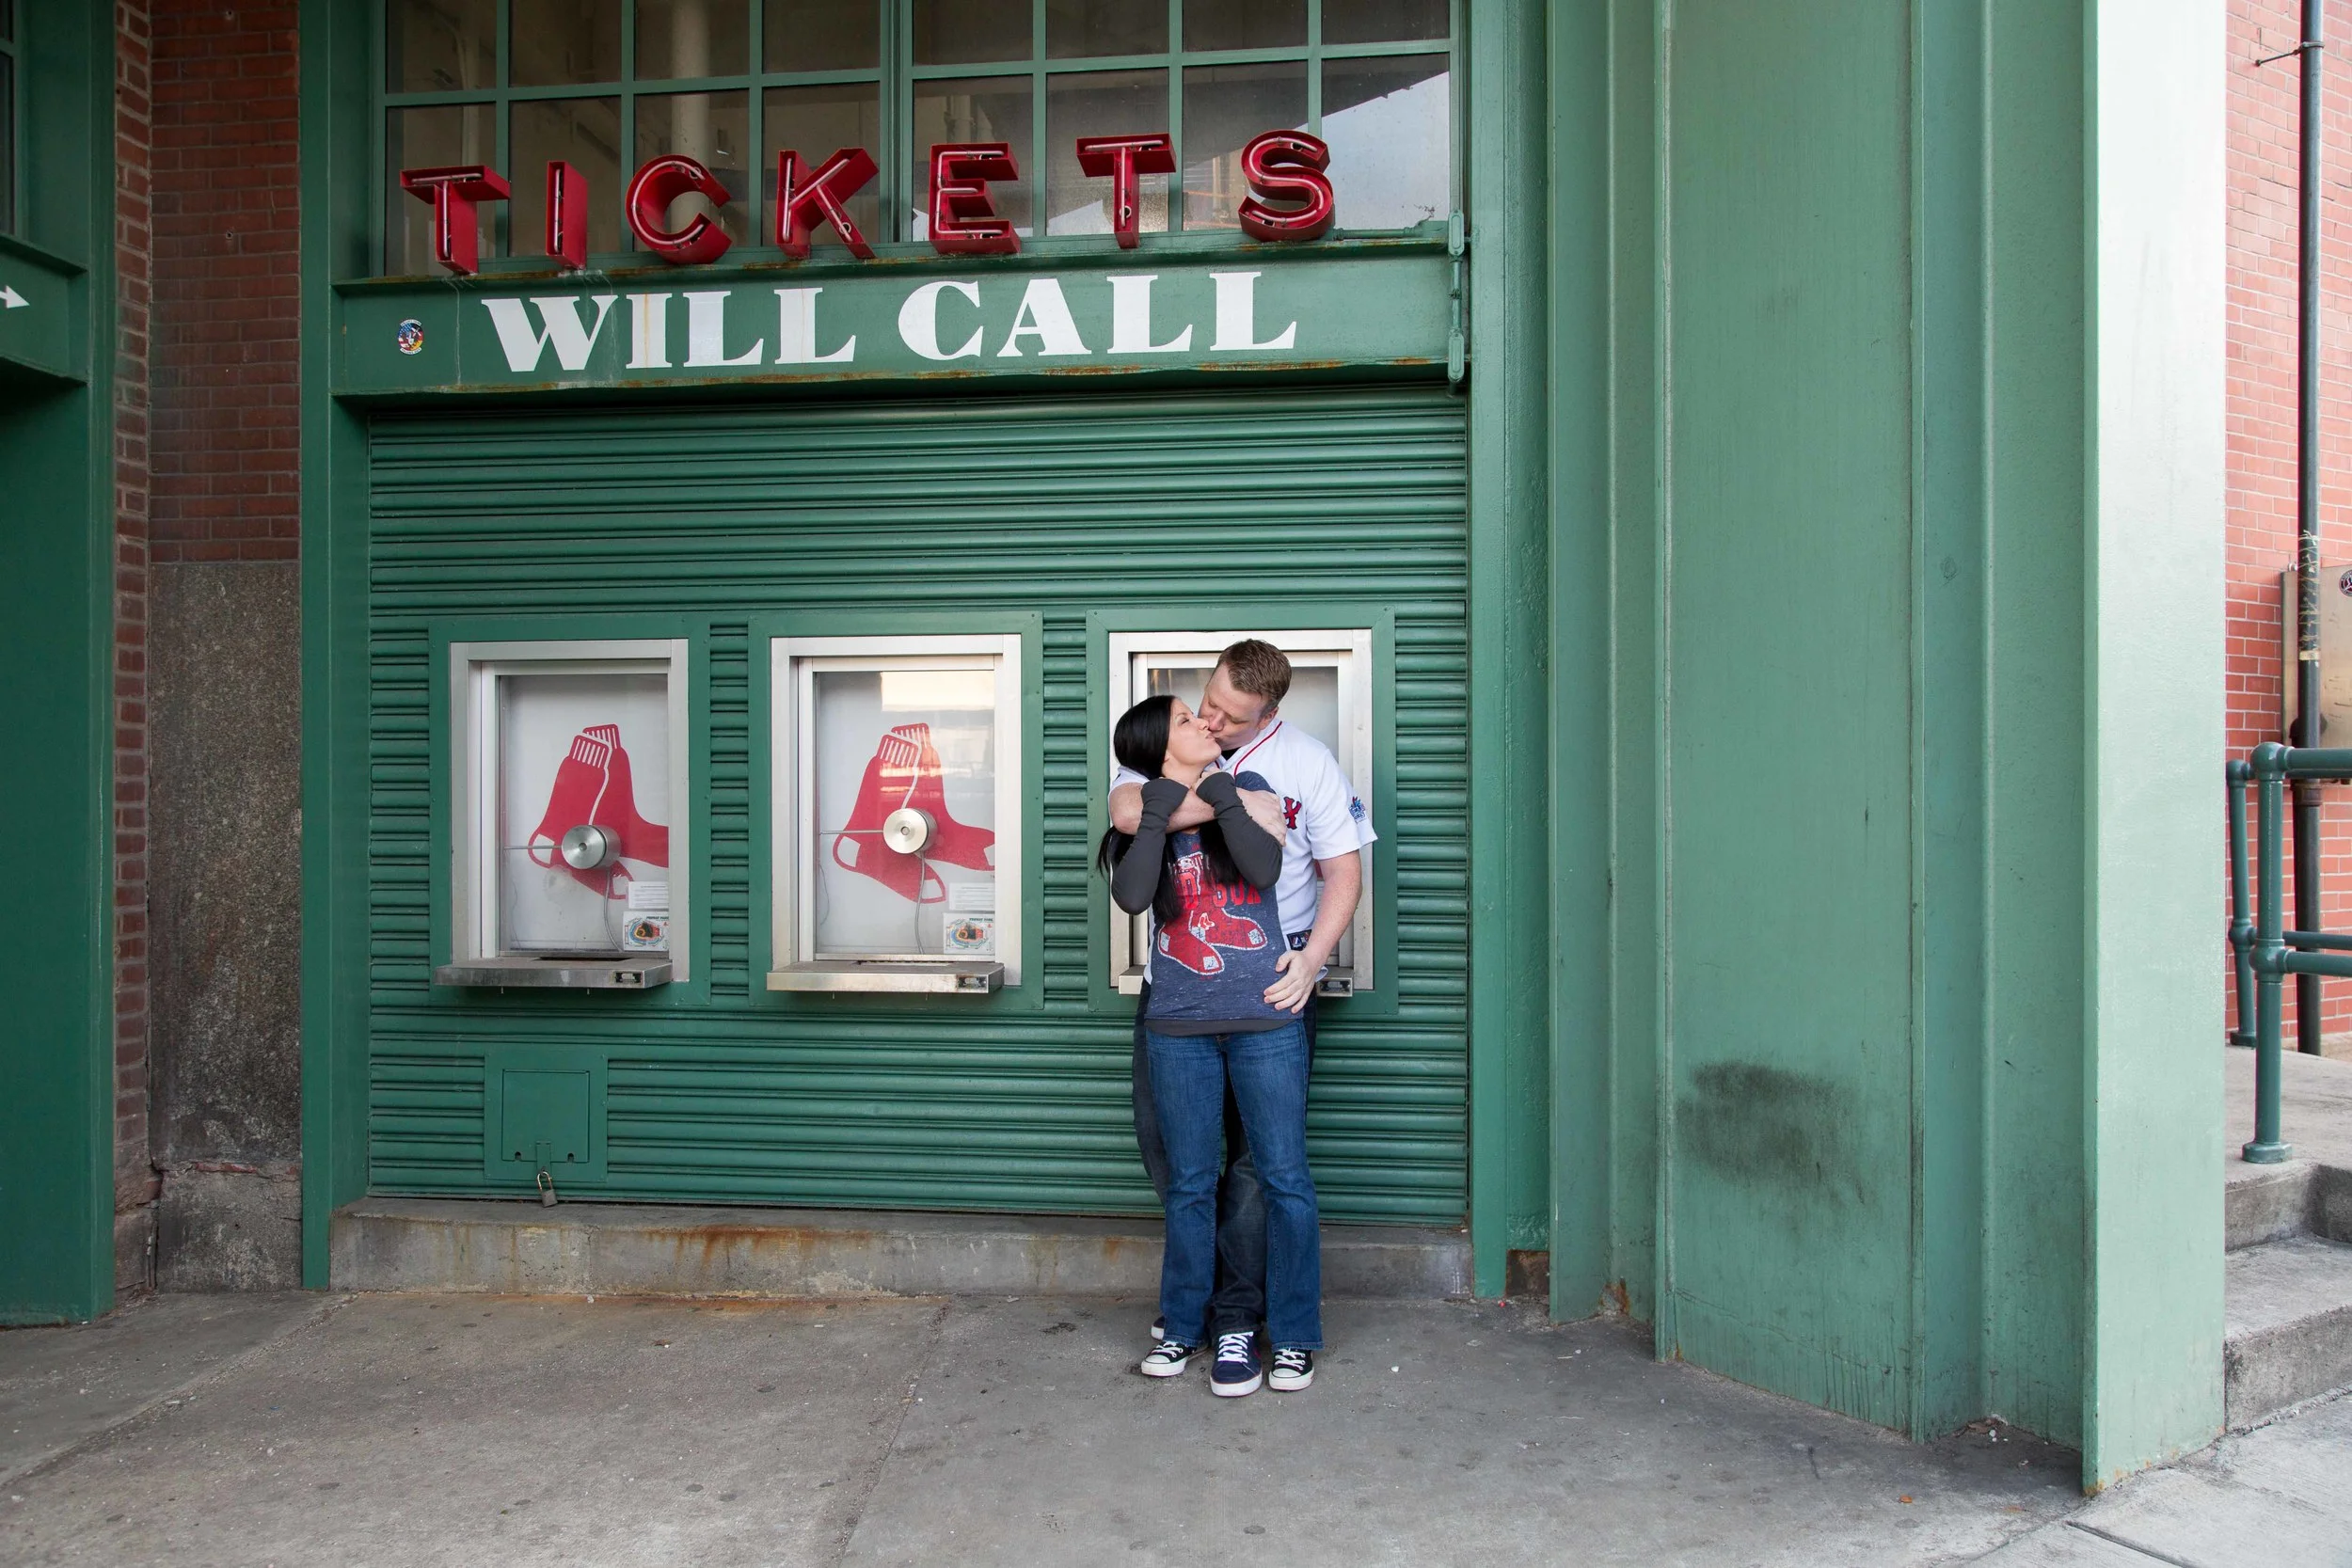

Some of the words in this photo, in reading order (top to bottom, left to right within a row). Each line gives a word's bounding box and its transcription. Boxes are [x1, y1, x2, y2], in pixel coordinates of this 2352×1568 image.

[400, 130, 1334, 274] TICKETS
[481, 286, 857, 372] WILL
[898, 271, 1297, 360] CALL
